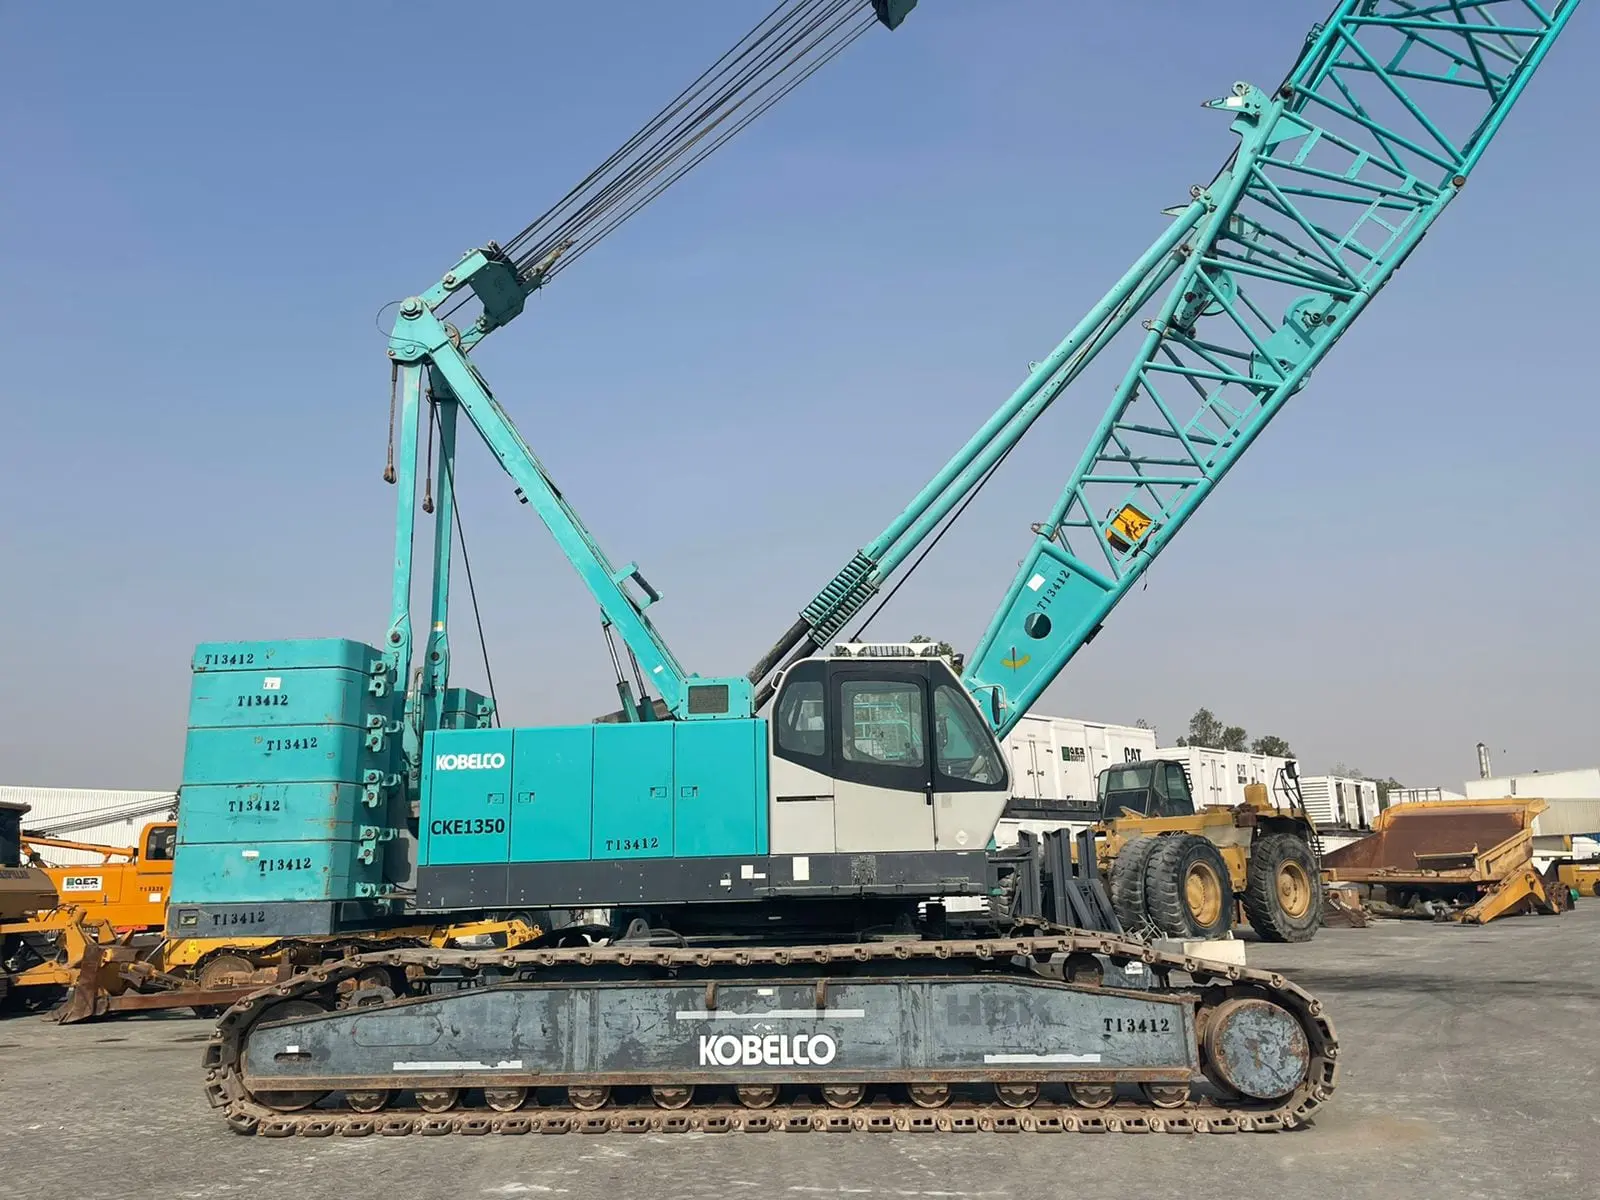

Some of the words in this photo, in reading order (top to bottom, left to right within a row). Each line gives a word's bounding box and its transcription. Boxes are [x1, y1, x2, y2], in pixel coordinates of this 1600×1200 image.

[435, 752, 506, 771] KOBELCO
[1124, 746, 1142, 763] CAT
[430, 818, 506, 835] CKE1350
[74, 877, 99, 886] QER
[699, 1033, 837, 1066] KOBELCO
